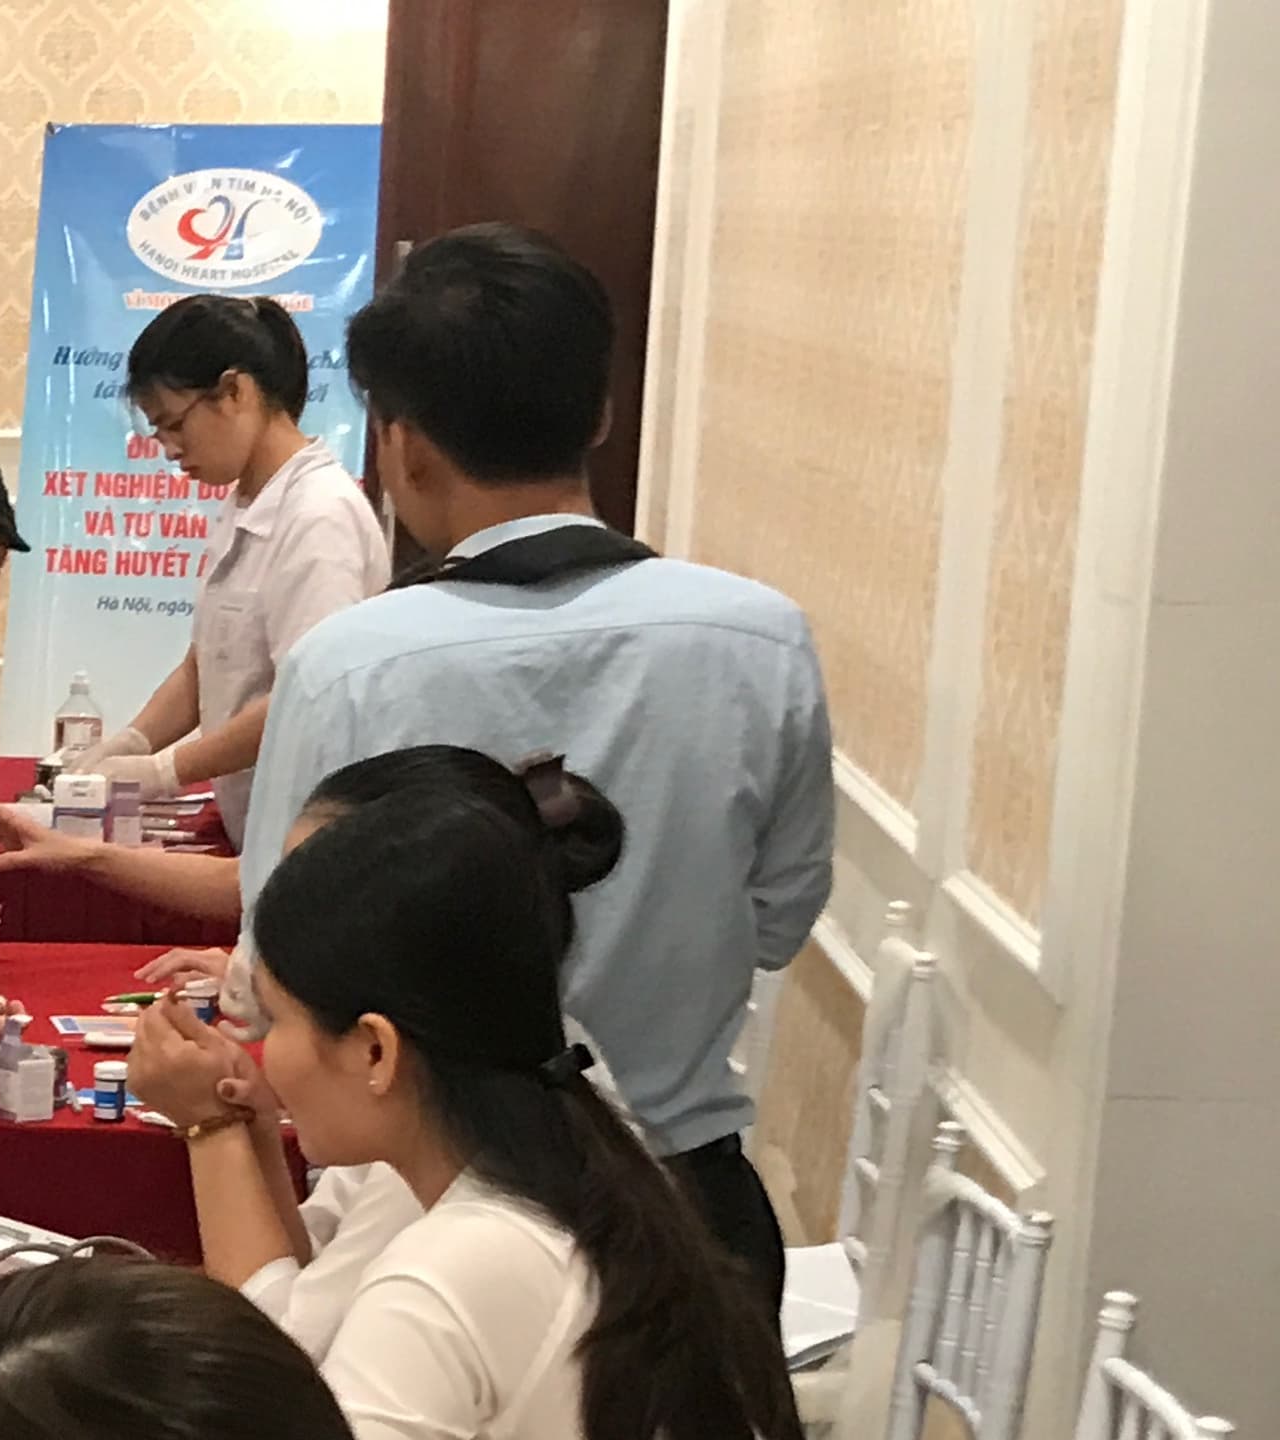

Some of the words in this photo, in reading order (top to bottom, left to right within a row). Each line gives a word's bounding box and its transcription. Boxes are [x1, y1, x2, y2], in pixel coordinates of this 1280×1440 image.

[228, 177, 256, 192] TIM
[139, 240, 179, 272] HANOI
[181, 264, 227, 281] HEART
[43, 467, 88, 497] XÉT
[94, 469, 191, 504] NGHIỆM
[84, 505, 115, 537] VÀ
[123, 510, 156, 538] TƯ
[45, 544, 108, 575] TĂNG
[115, 544, 191, 578] HUYẾT
[97, 597, 119, 611] Hà
[123, 597, 153, 613] Nội,
[157, 598, 195, 616] ngày
